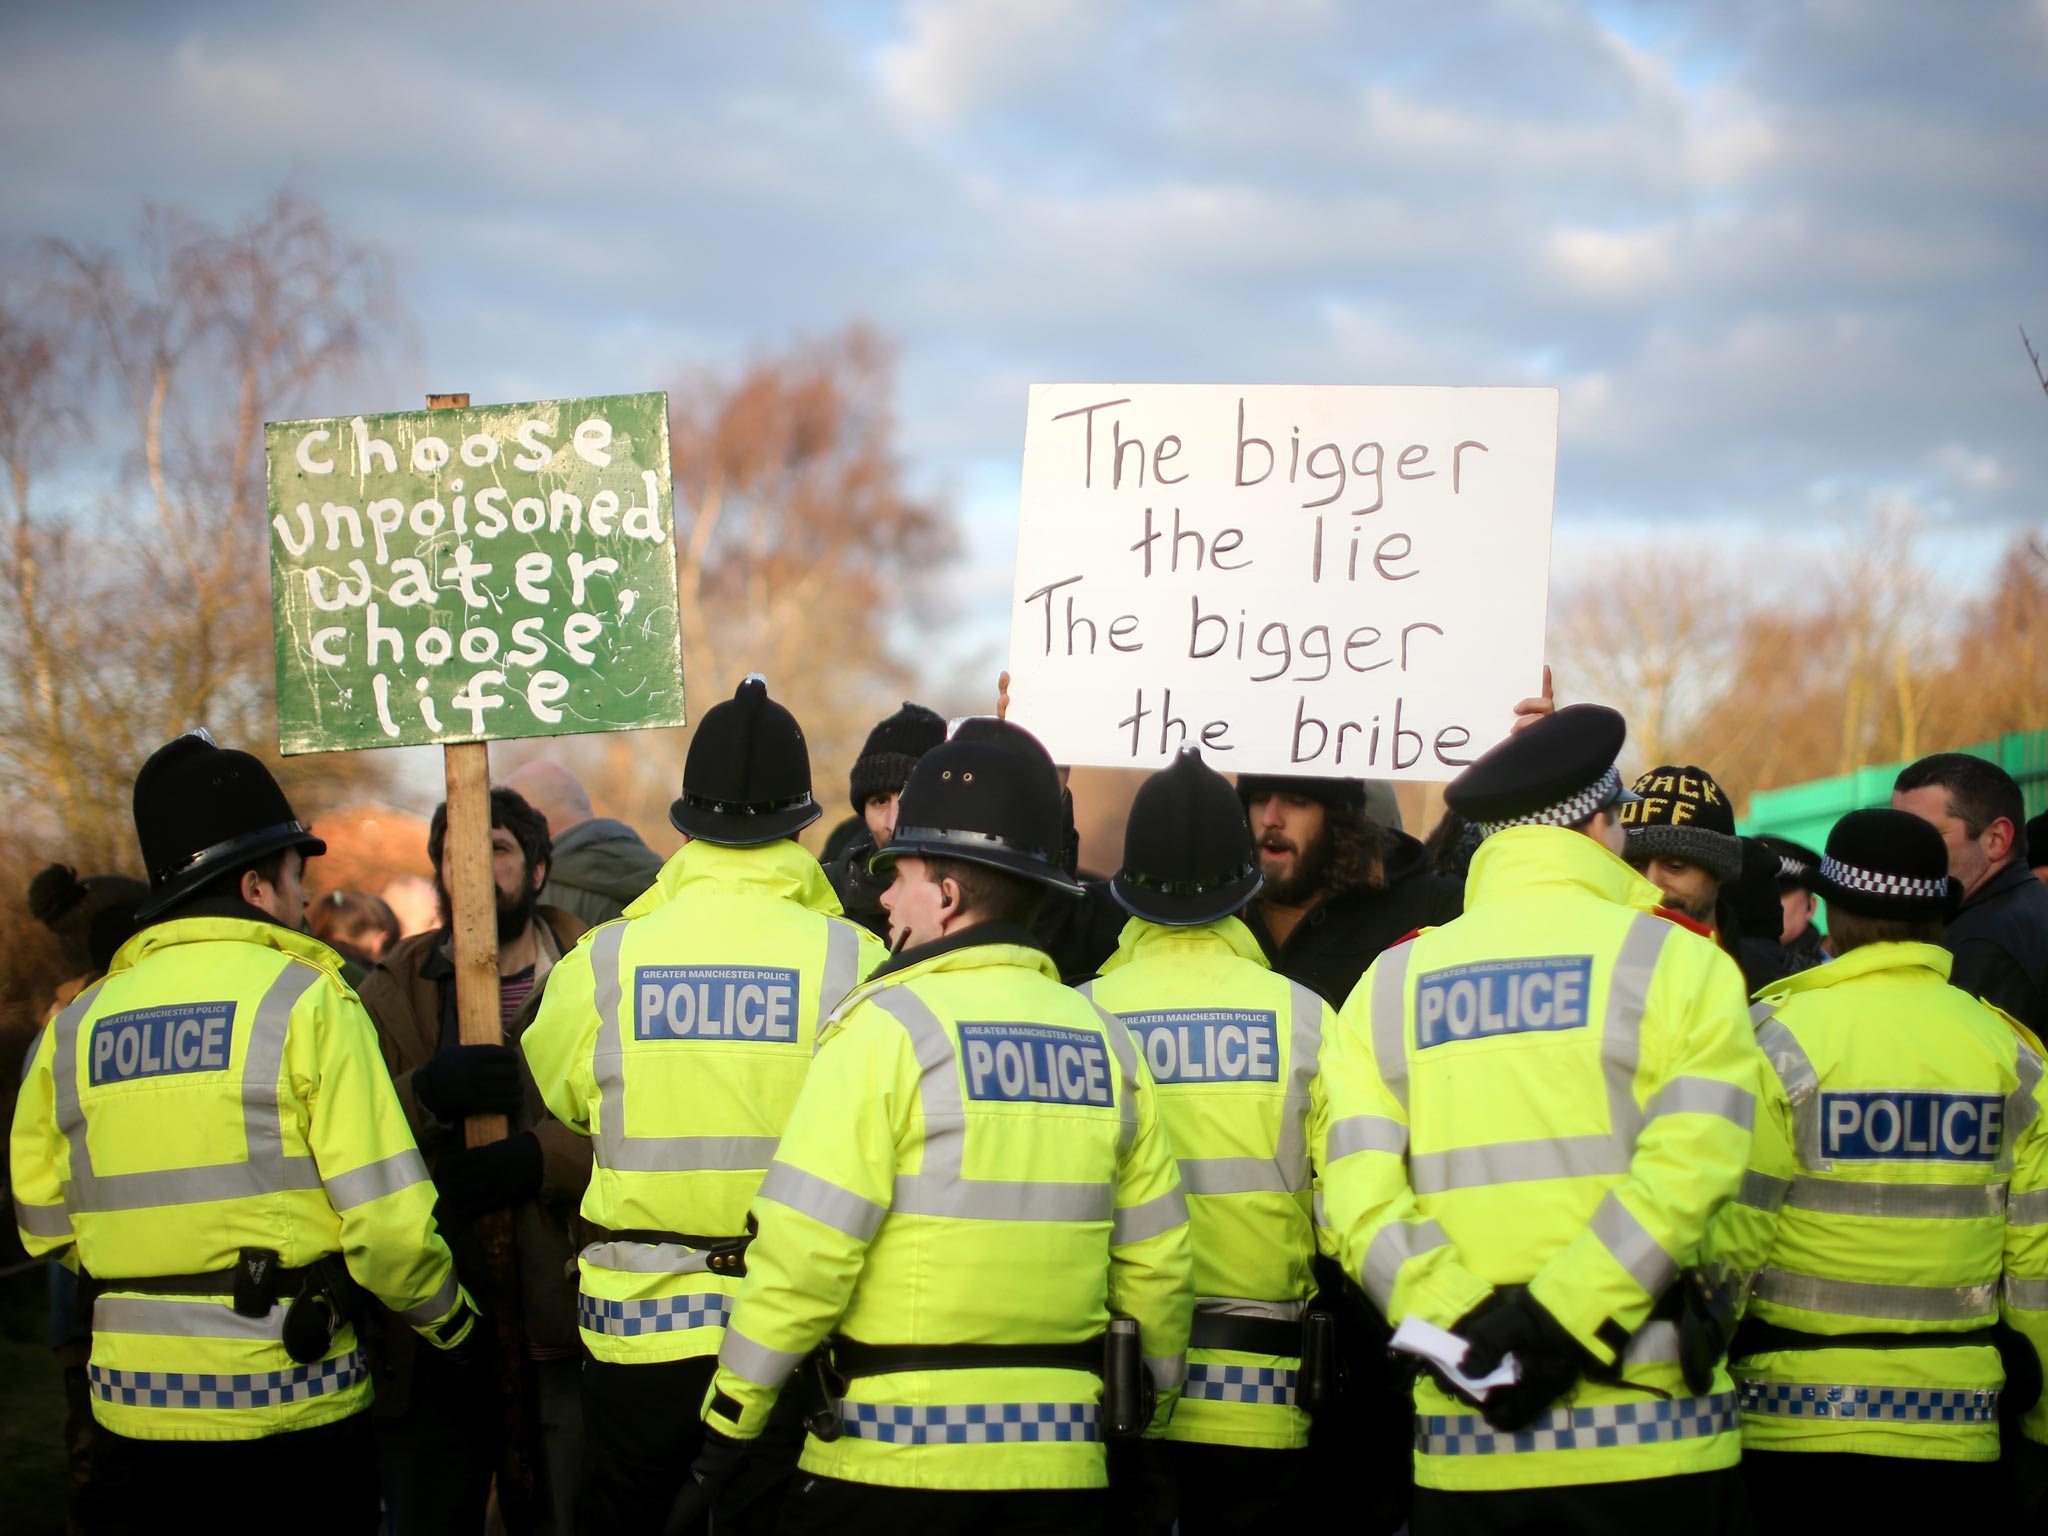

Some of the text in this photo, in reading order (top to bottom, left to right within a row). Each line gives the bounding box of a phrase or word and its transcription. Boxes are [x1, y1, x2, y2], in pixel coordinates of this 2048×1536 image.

[296, 416, 612, 475] choose
[1051, 397, 1489, 516] The bigger
[272, 470, 666, 564] unpoisoned
[1130, 507, 1420, 583] the lie
[308, 544, 636, 614] water,
[310, 602, 602, 666] choose
[1024, 575, 1444, 682] The bigger
[372, 670, 570, 738] life
[1118, 687, 1476, 770] the bribe
[1619, 797, 1696, 826] OFF
[642, 970, 790, 981] GREATER MANCHESTER POLICE
[1421, 970, 1583, 1043] POLICE
[100, 1005, 227, 1028] GREATER MANCHESTER POLICE
[640, 982, 792, 1038] POLICE
[964, 1026, 1097, 1043] GREATER MANCHESTER POLICE
[1120, 1012, 1268, 1025] GREATER MANCHESTER POLICE
[94, 1018, 226, 1080] POLICE
[966, 1039, 1108, 1102] POLICE
[1829, 1099, 2003, 1155] POLICE
